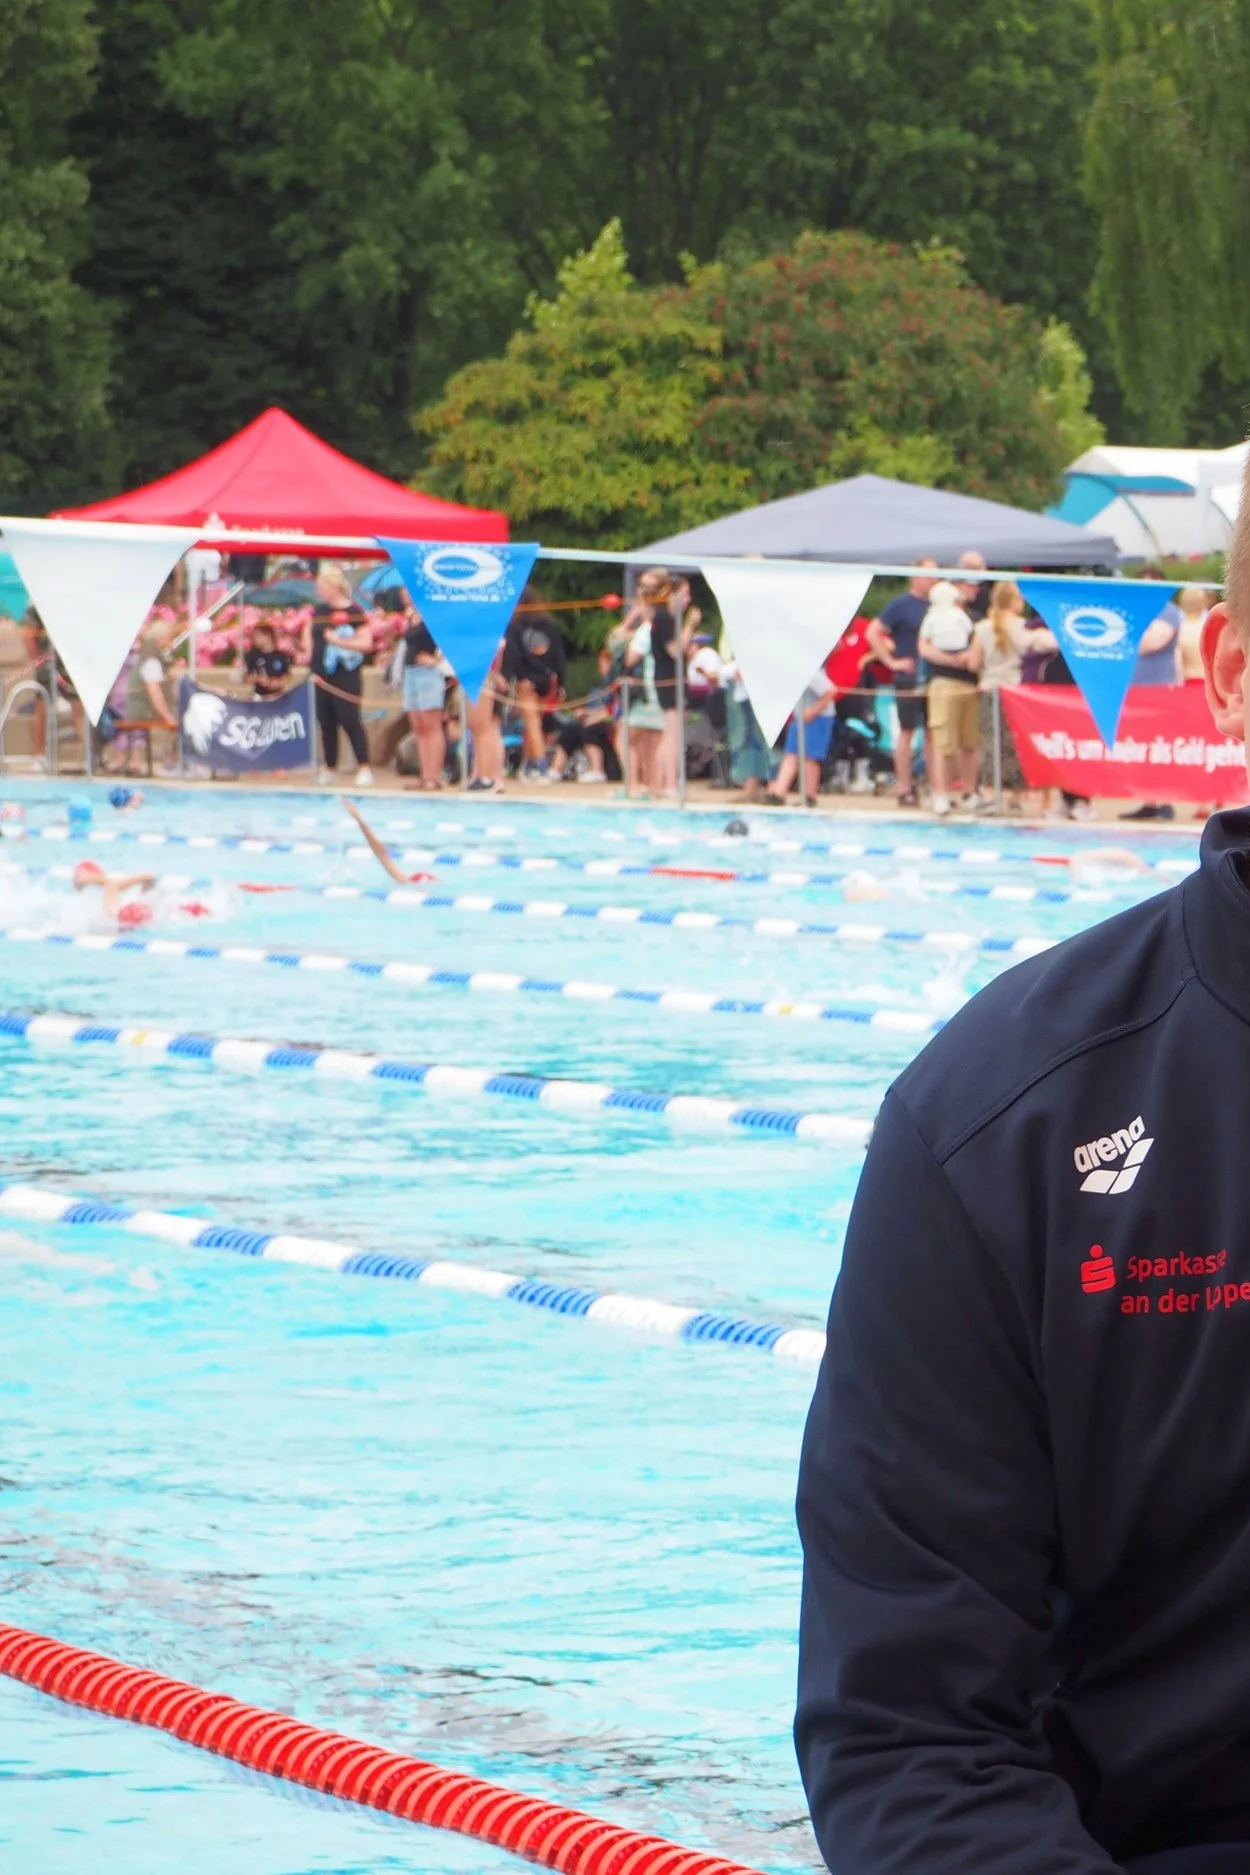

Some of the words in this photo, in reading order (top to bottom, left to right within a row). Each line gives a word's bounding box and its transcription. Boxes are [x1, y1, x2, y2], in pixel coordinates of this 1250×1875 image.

[1074, 1115, 1146, 1173] arena
[1120, 1294, 1150, 1314] an
[1158, 1288, 1200, 1314] der
